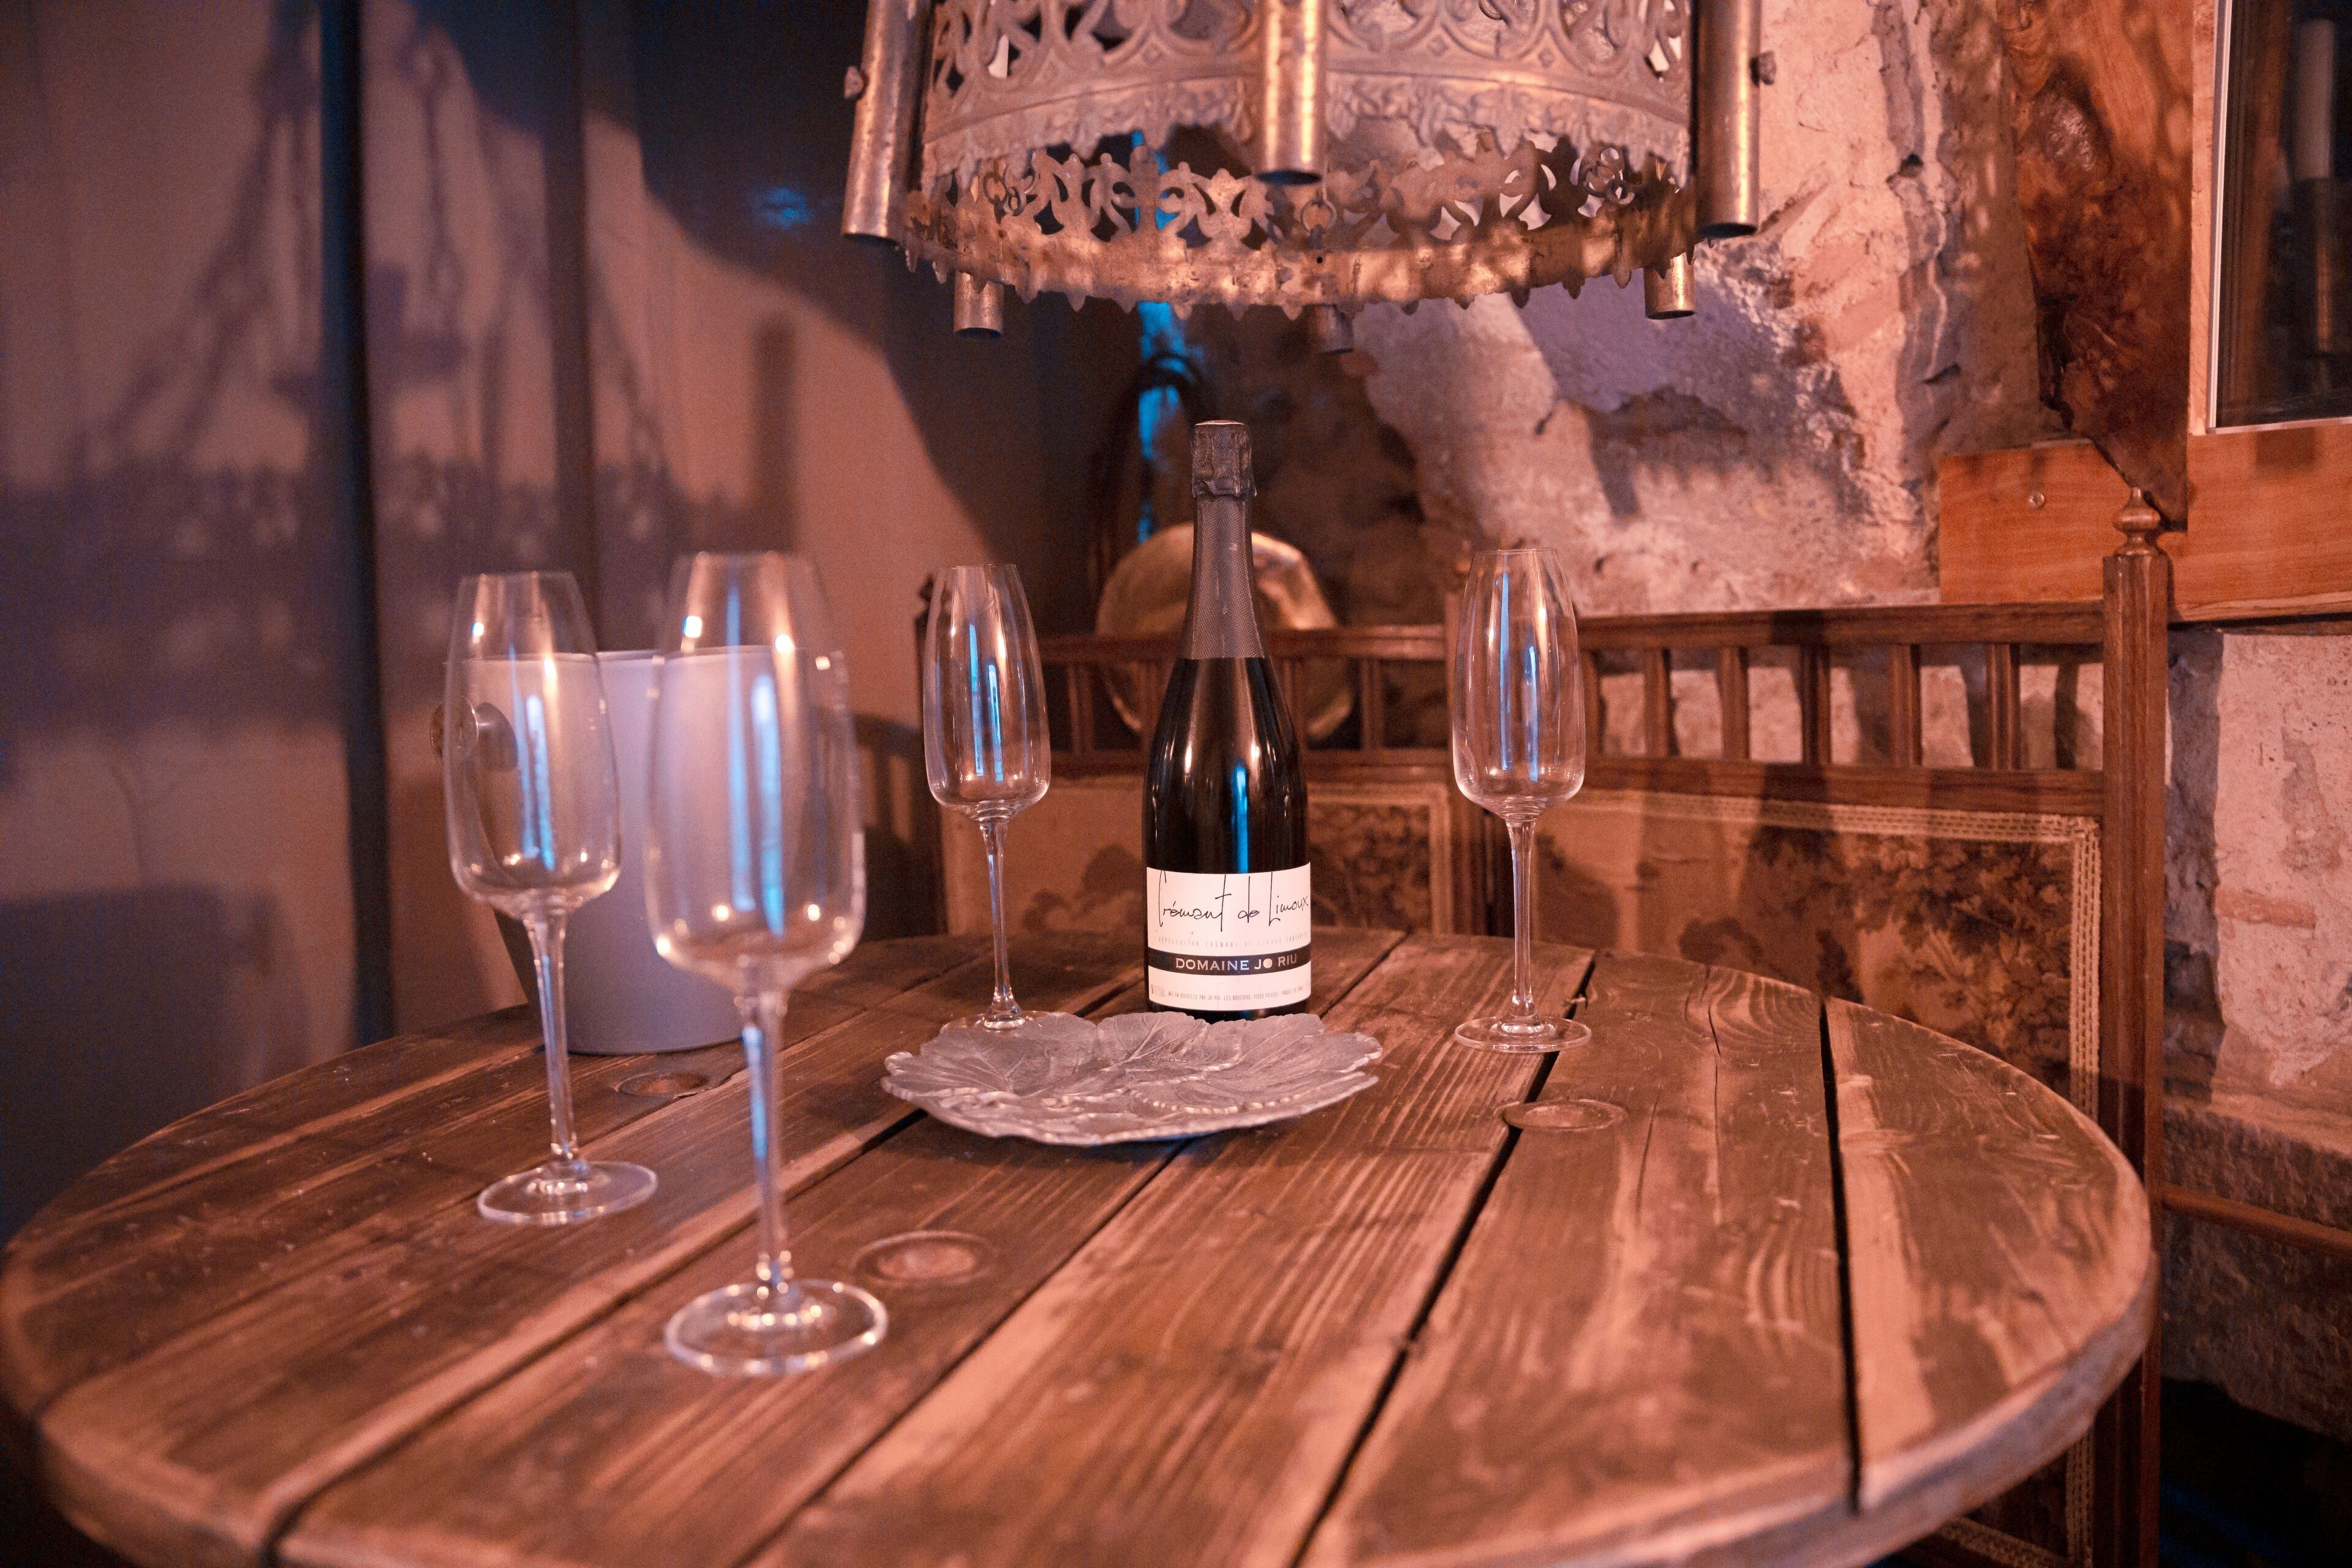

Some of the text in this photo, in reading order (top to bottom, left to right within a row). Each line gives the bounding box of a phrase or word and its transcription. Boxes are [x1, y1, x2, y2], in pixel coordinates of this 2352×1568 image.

[1237, 875, 1260, 923] de
[1175, 953, 1297, 971] DOMAINE JO RIU
